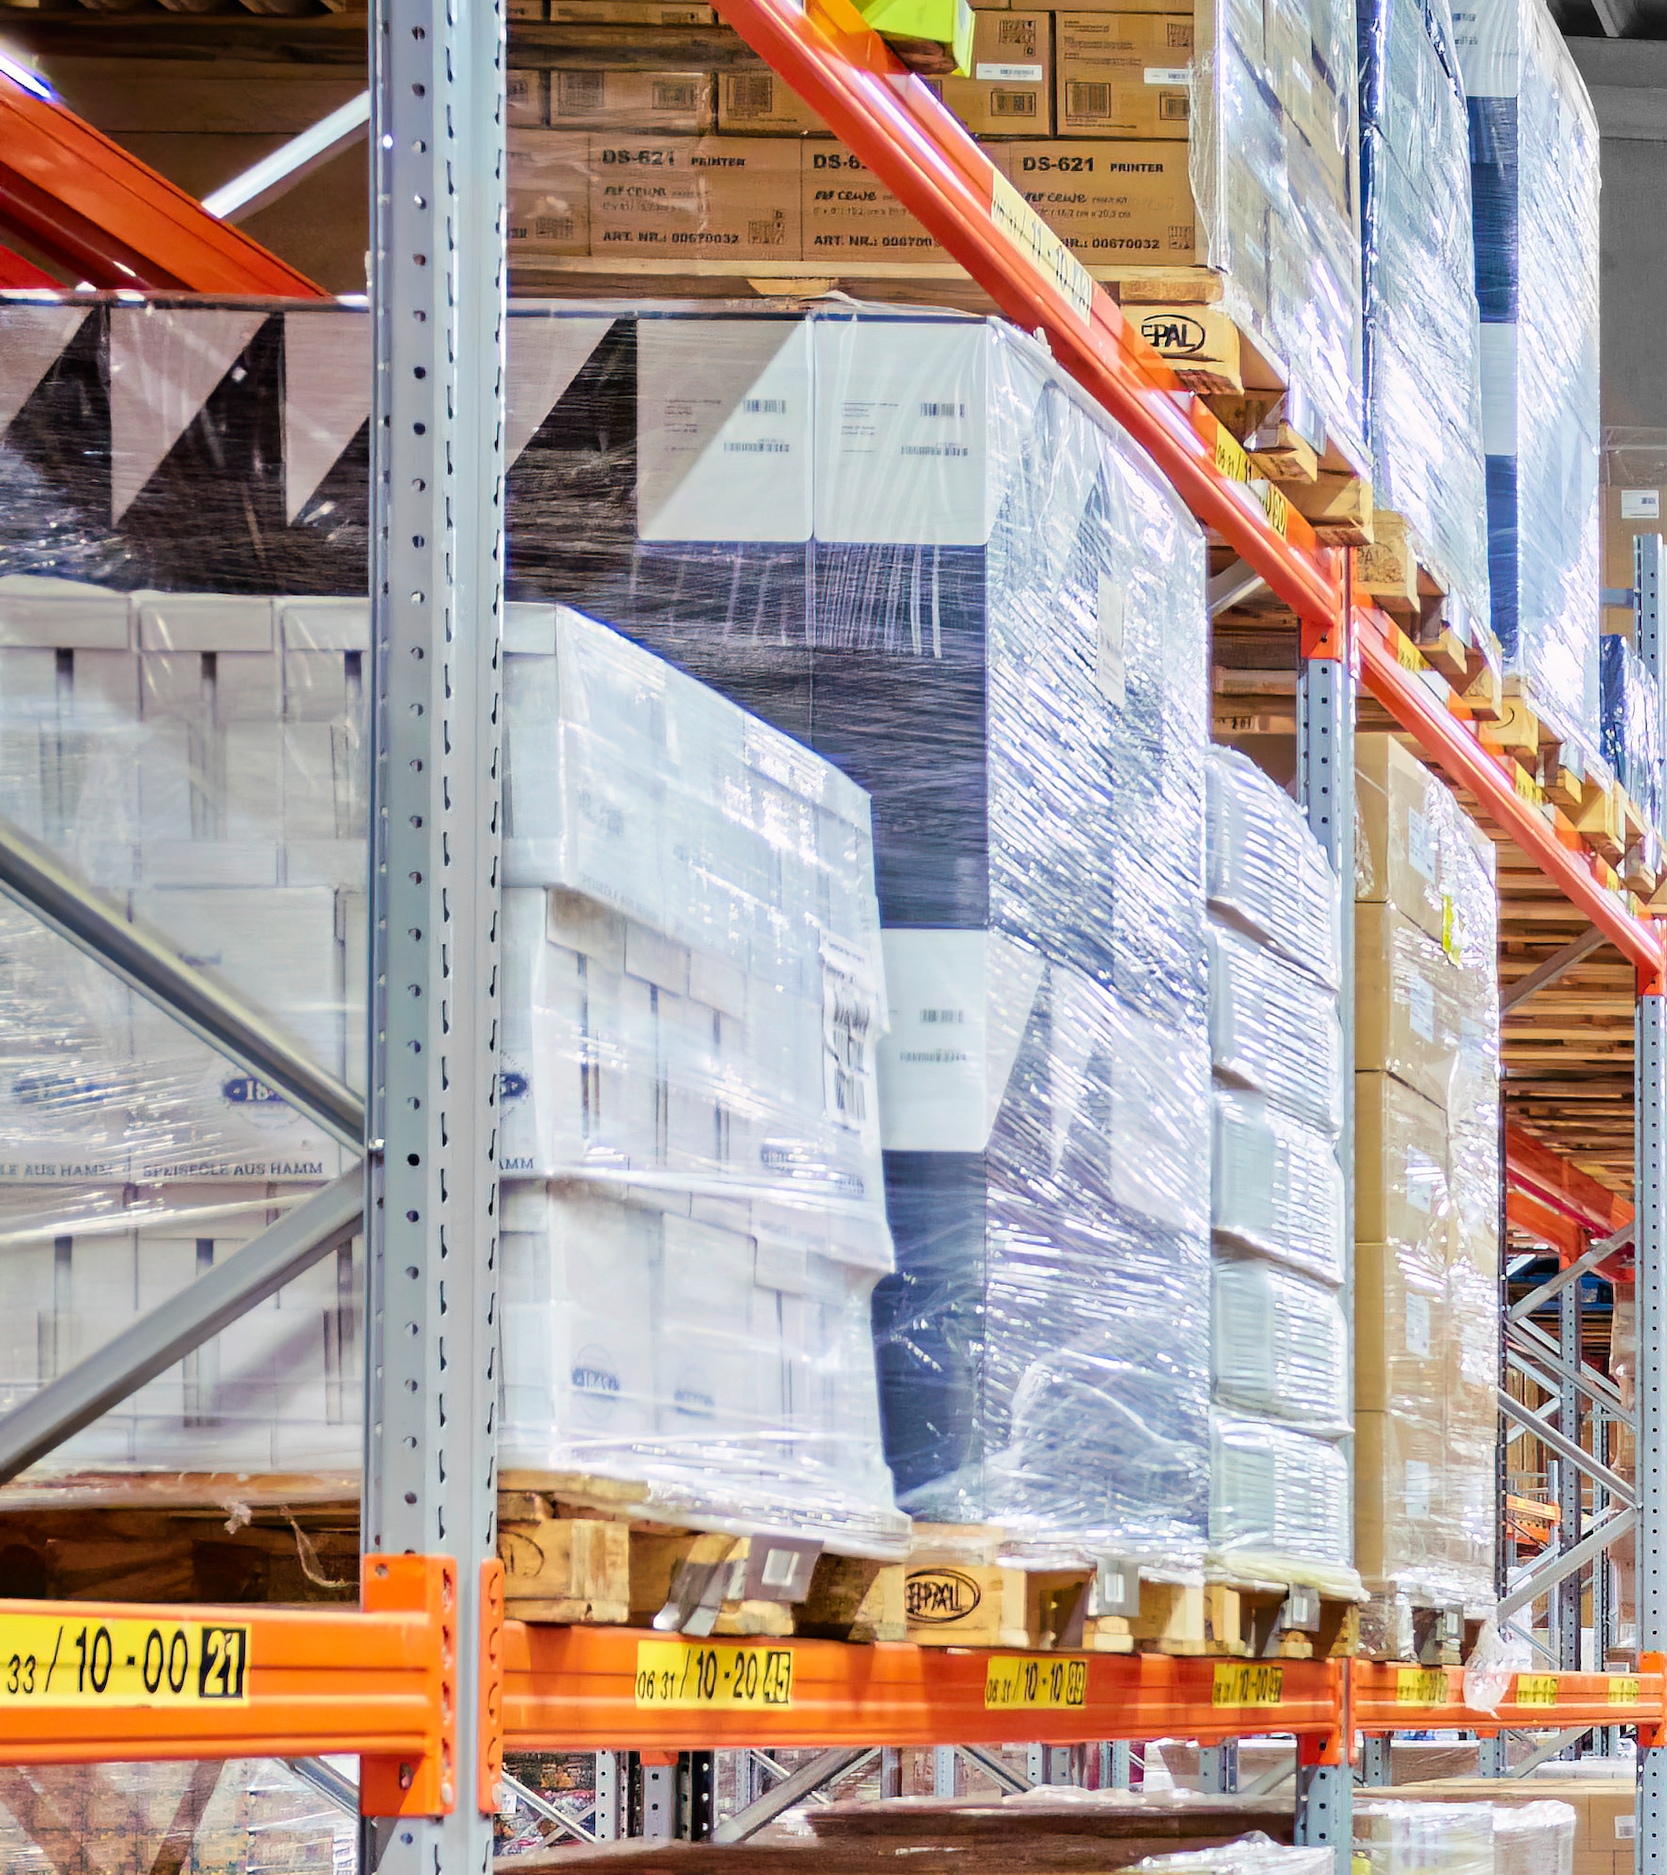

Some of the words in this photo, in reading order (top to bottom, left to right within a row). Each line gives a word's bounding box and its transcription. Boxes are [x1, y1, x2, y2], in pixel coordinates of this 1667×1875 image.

[1024, 157, 1094, 173] DS-621
[1110, 162, 1163, 174] PRINTER
[814, 235, 843, 246] ART.
[1092, 238, 1160, 250] 00670032
[234, 1163, 265, 1176] AUS
[270, 1162, 323, 1176] HAMM
[7, 1653, 37, 1694] 33
[202, 1628, 245, 1698] 21
[637, 1669, 656, 1700] 06
